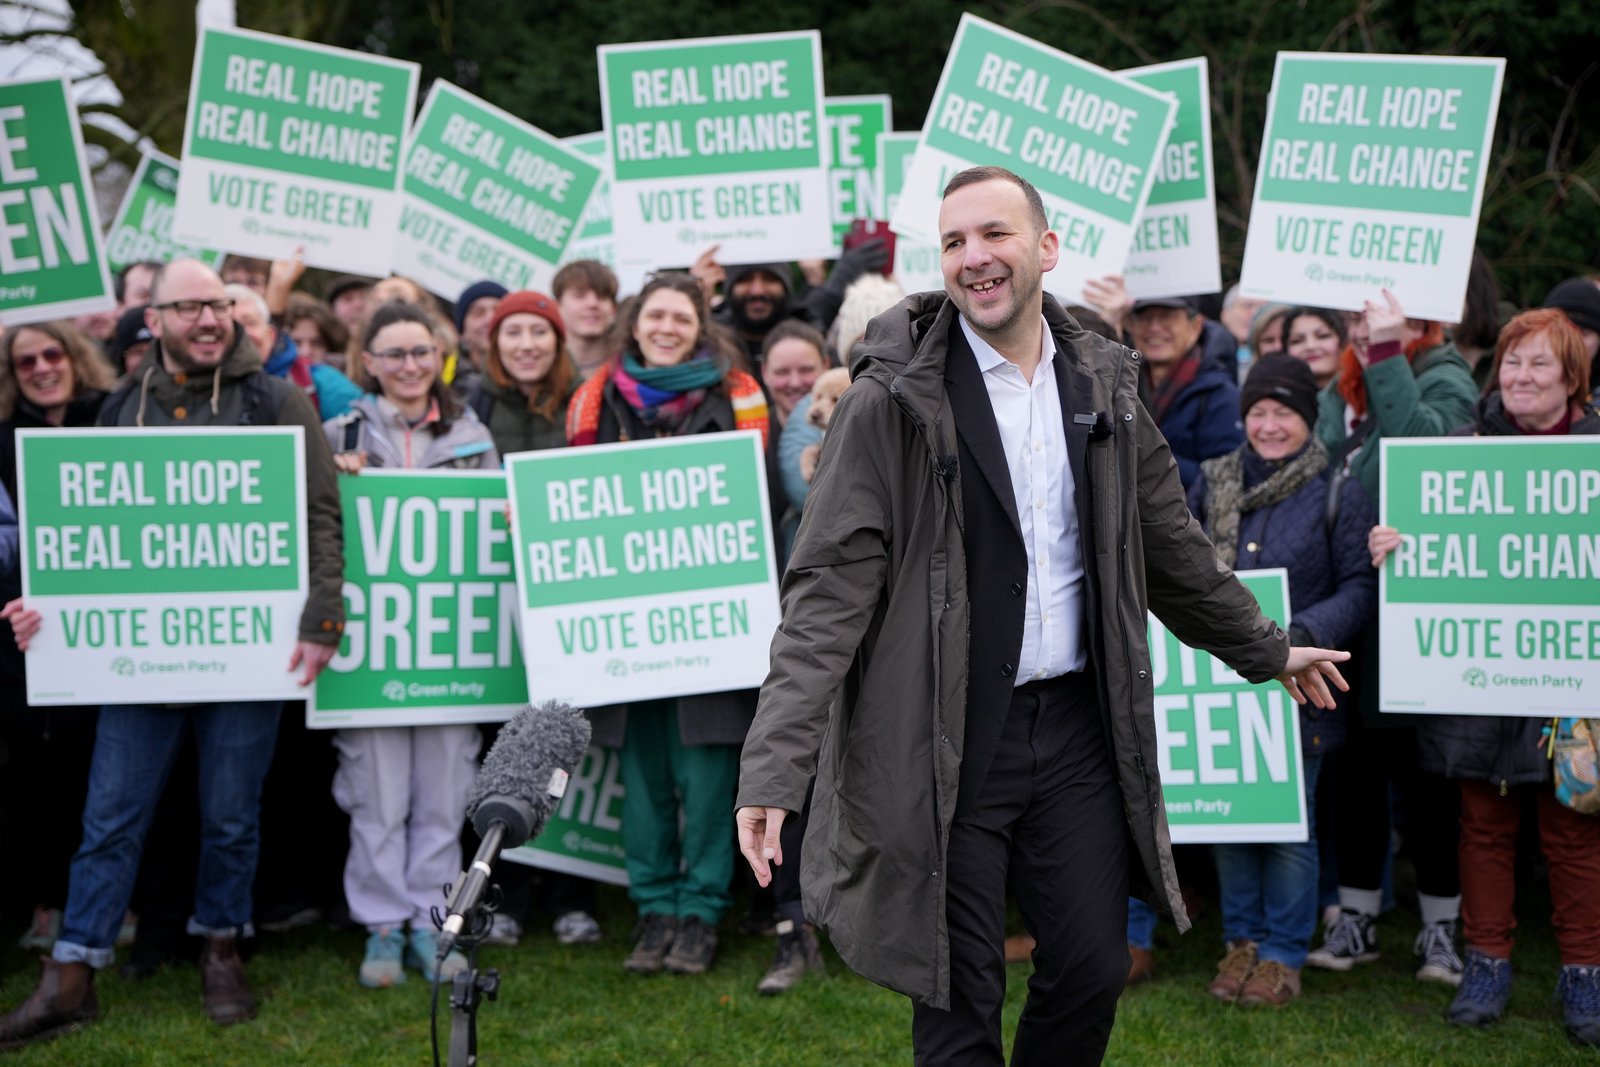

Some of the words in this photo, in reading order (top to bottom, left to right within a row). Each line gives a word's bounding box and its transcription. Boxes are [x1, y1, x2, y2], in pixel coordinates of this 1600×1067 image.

[225, 54, 298, 105] REAL
[306, 70, 384, 119] HOPE
[632, 67, 707, 108] REAL
[712, 60, 789, 103] HOPE
[976, 51, 1049, 113] REAL
[1055, 84, 1138, 146] HOPE
[1298, 83, 1371, 126] REAL
[1379, 86, 1462, 130] HOPE
[198, 101, 272, 151] REAL
[280, 117, 397, 172] CHANGE
[440, 112, 505, 170] REAL
[505, 146, 576, 203] HOPE
[617, 122, 692, 161] REAL
[696, 111, 813, 157] CHANGE
[822, 114, 863, 167] TE
[938, 93, 1012, 155] REAL
[1020, 123, 1142, 203] CHANGE
[1269, 139, 1340, 183] REAL
[1348, 144, 1474, 192] CHANGE
[209, 172, 279, 213] VOTE
[285, 192, 373, 229] GREEN
[407, 144, 470, 201] REAL
[470, 177, 572, 249] CHANGE
[637, 187, 707, 223] VOTE
[714, 181, 802, 217] GREEN
[399, 204, 460, 256] VOTE
[457, 236, 534, 289] GREEN
[1045, 205, 1105, 259] EEN
[1130, 213, 1190, 253] EEN
[1276, 215, 1343, 257] VOTE
[1350, 222, 1443, 265] GREEN
[1326, 270, 1361, 284] Green
[1364, 273, 1396, 288] Party
[59, 461, 156, 507] REAL
[165, 459, 262, 504] HOPE
[545, 474, 634, 523] REAL
[640, 463, 730, 513] HOPE
[1420, 470, 1514, 515] REAL
[1526, 469, 1600, 515] HOP
[35, 525, 132, 571] REAL
[140, 522, 290, 569] CHANGE
[356, 496, 511, 577] VOTE
[528, 536, 618, 586] REAL
[624, 519, 760, 574] CHANGE
[1394, 533, 1488, 578] REAL
[1499, 533, 1600, 580] CHAN
[60, 608, 149, 648] VOTE
[161, 606, 272, 646] GREEN
[557, 610, 637, 655] VOTE
[648, 599, 750, 645] GREEN
[1414, 618, 1503, 659] VOTE
[1516, 619, 1600, 660] GREE
[139, 660, 183, 674] Green
[187, 659, 227, 674] Party
[632, 657, 675, 673] Green
[678, 654, 710, 672] Party
[1493, 674, 1538, 688] Green
[1542, 674, 1583, 690] Party
[408, 681, 447, 699] Green
[450, 681, 486, 701] Party
[1153, 689, 1289, 785] EEN
[1195, 799, 1232, 817] Party
